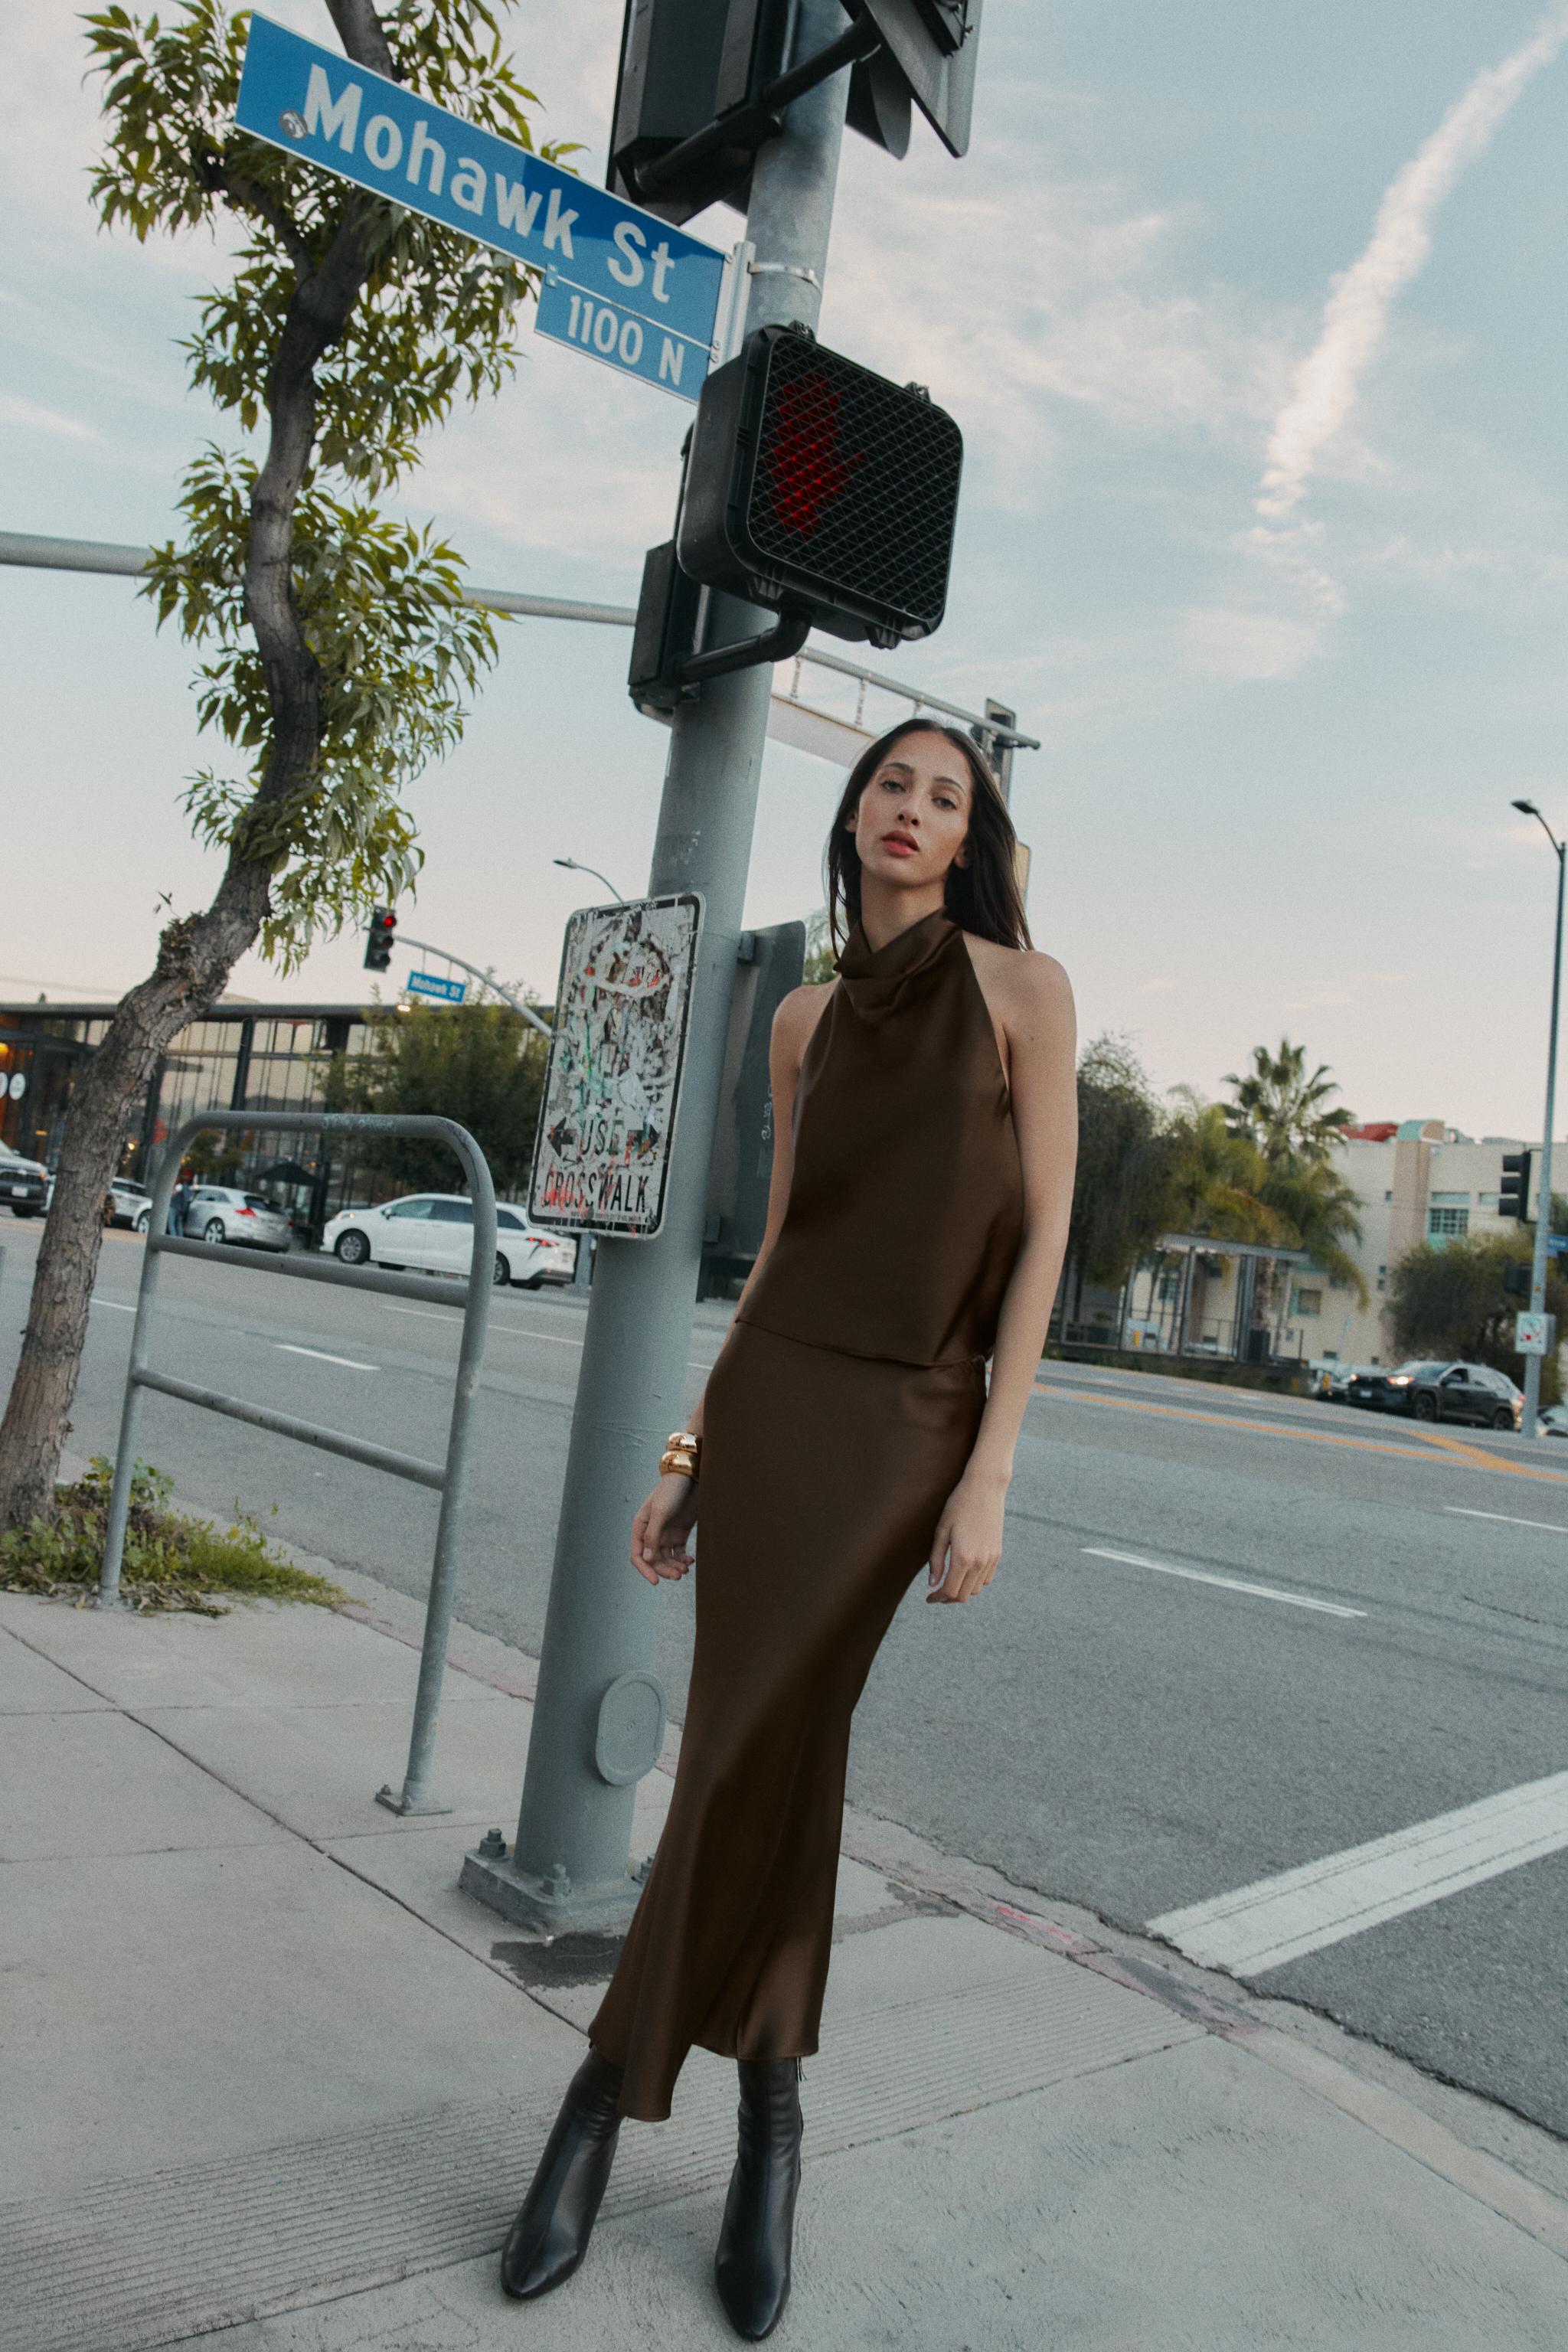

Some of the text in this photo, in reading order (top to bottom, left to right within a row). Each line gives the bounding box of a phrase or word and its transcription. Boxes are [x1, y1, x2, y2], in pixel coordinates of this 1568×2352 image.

[304, 63, 676, 304] Mohawk St
[567, 293, 685, 386] 1100 N
[411, 975, 447, 995] Mohawk
[580, 1119, 626, 1156] USE
[544, 1171, 649, 1213] CROSSWALK
